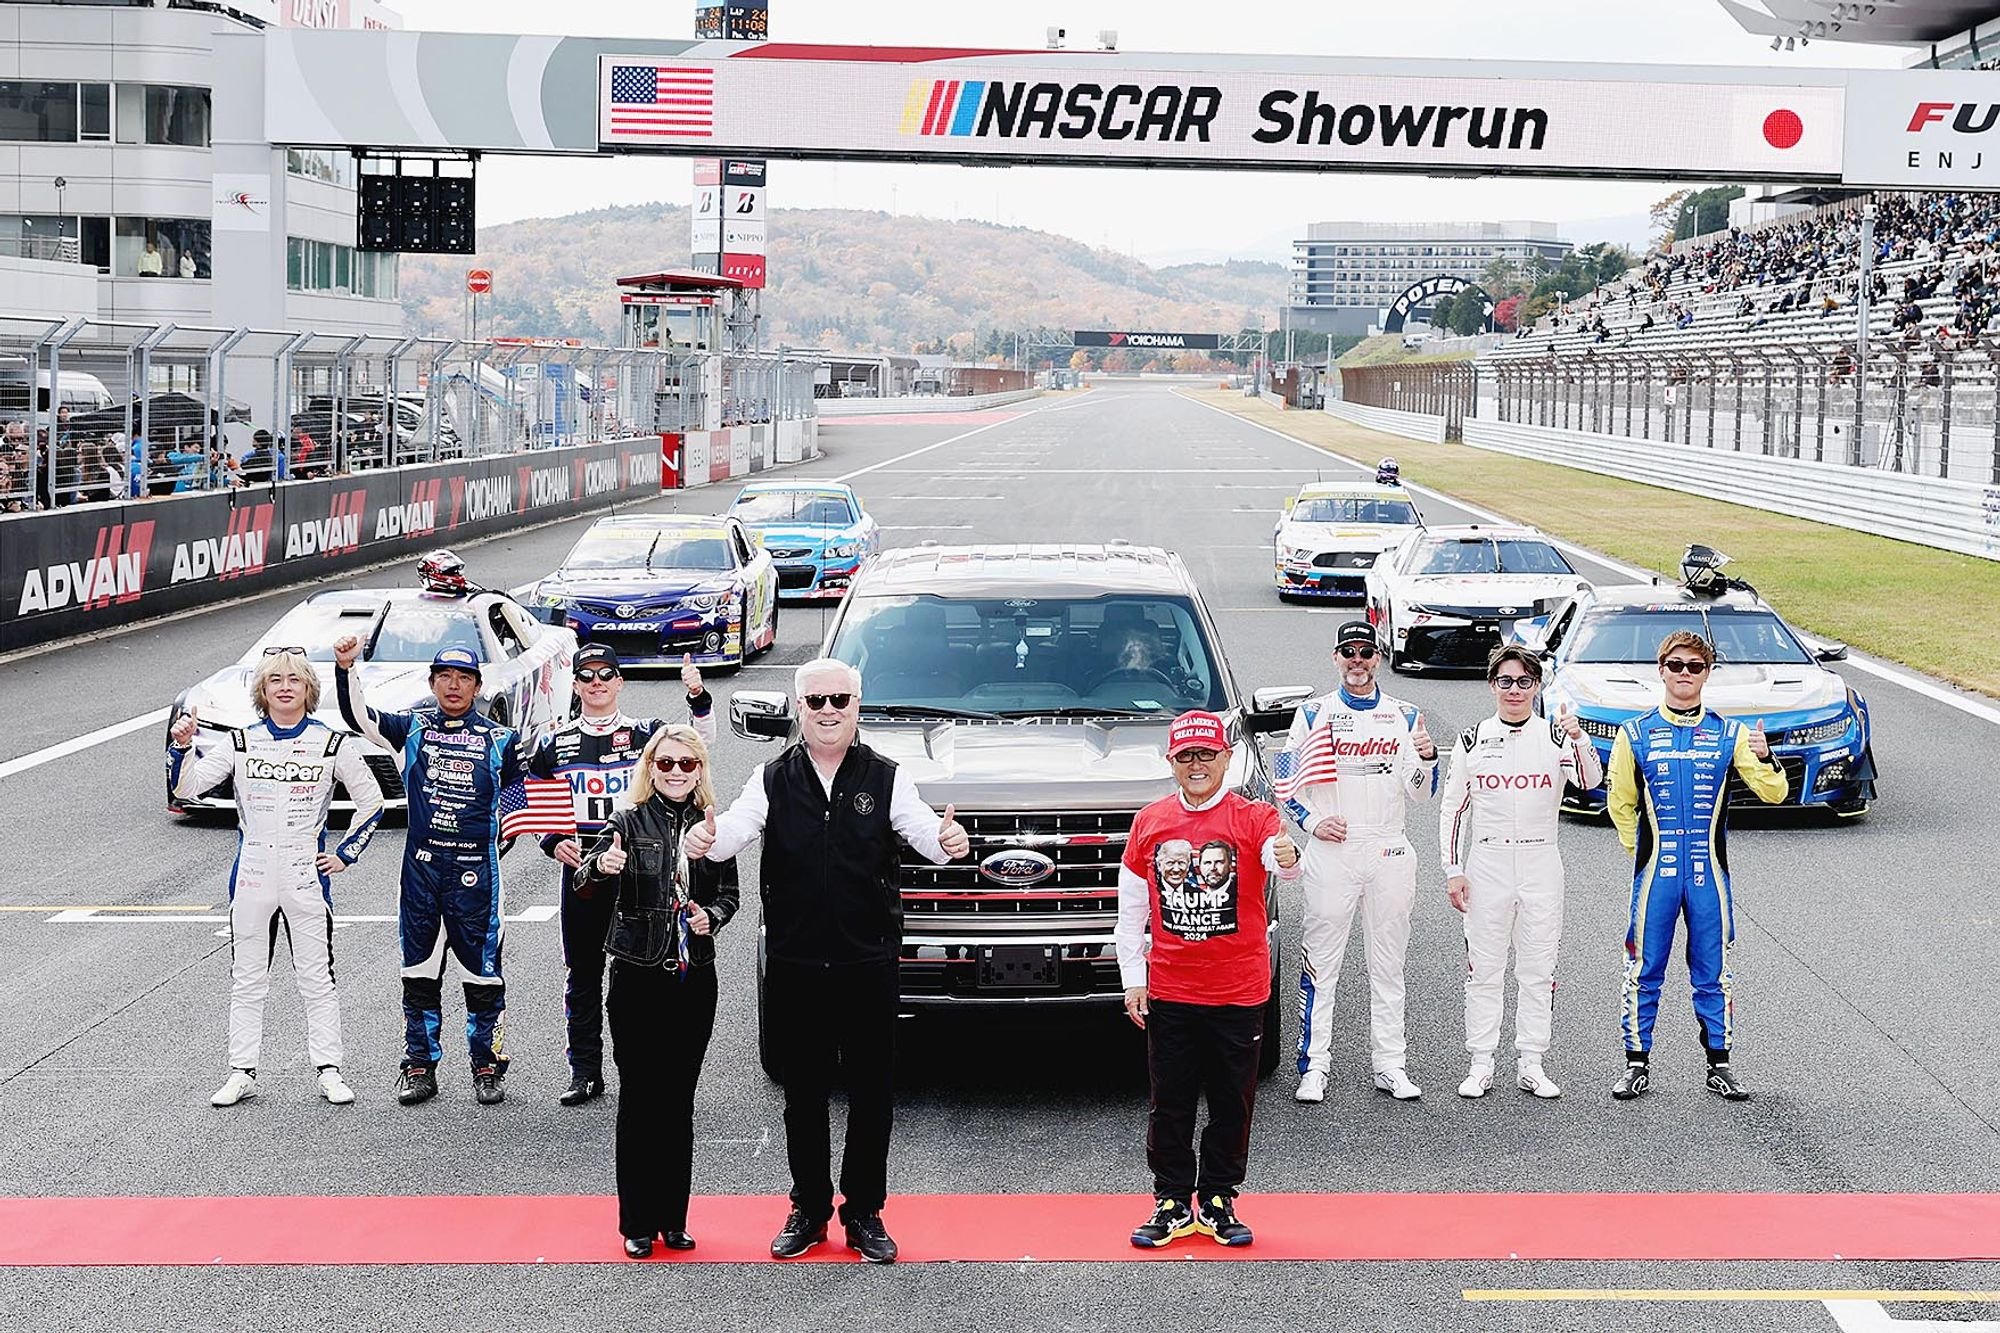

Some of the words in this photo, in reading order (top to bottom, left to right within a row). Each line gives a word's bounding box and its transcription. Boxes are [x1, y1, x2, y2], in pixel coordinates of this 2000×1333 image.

[730, 7, 744, 16] LAP
[752, 9, 767, 20] 24
[731, 18, 766, 31] 11:08
[975, 81, 1222, 142] NASCAR
[1251, 90, 1548, 150] Showrun
[737, 232, 764, 241] NIPPO
[1126, 335, 1185, 346] YOKOHAMA
[18, 551, 141, 615] ADVAN
[170, 530, 263, 584] ADVAN
[285, 513, 359, 559] ADVAN
[375, 500, 434, 540] ADVAN
[465, 475, 512, 521] YOKOHAMA
[531, 465, 570, 507] YOKOHAMA
[584, 458, 618, 496] YOKOHAMA
[629, 452, 658, 486] YOKOHAMA
[1662, 604, 1711, 612] NASCAR
[591, 622, 662, 633] CAMRY
[1174, 728, 1194, 740] GREAT
[1195, 728, 1216, 738] AGAIN
[246, 759, 322, 782] KeePer
[565, 770, 631, 795] Mobi
[1476, 774, 1552, 789] TOYOTA
[290, 786, 316, 794] ZENT
[1001, 860, 1036, 875] Ford
[1162, 891, 1230, 908] TRUMP
[1171, 912, 1221, 925] VANCE
[1173, 924, 1196, 932] AMERICA
